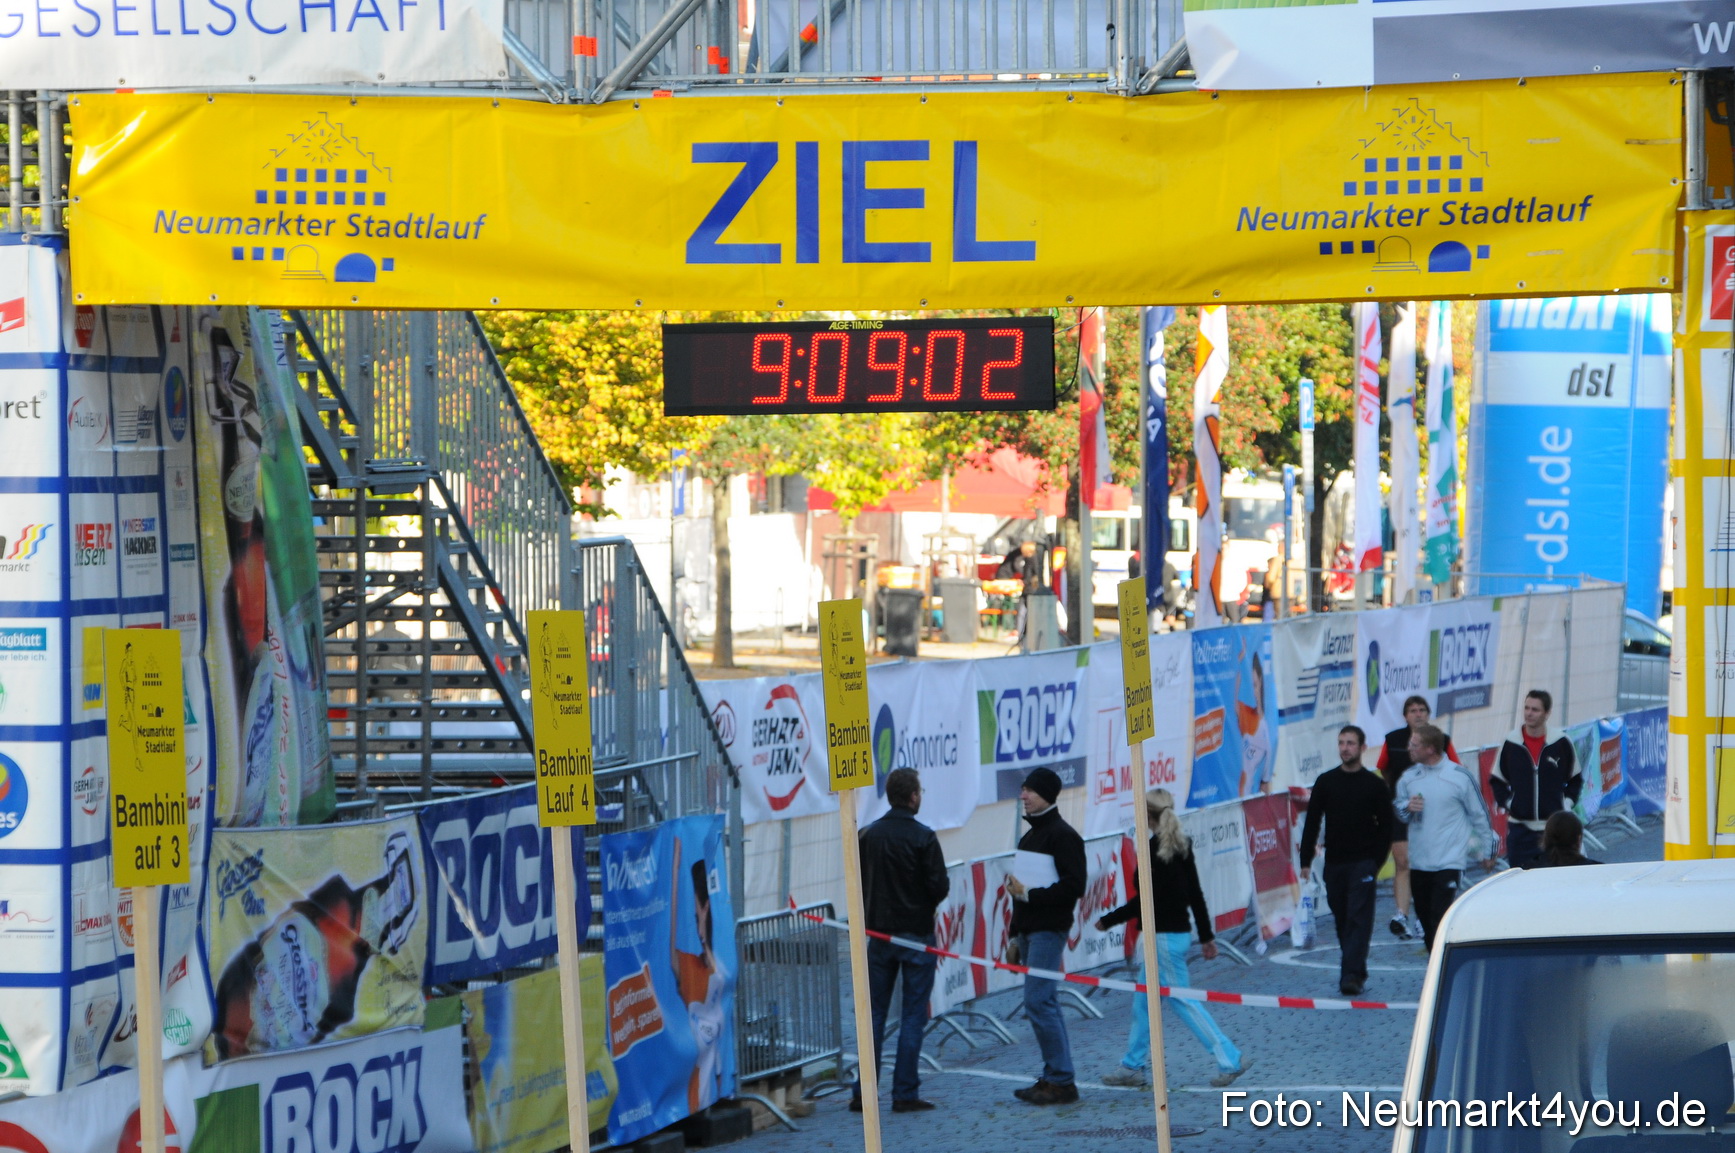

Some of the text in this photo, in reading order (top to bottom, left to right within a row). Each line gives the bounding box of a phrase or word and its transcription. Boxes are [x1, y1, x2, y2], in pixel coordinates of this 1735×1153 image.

[685, 140, 1037, 264] ZIEL
[1237, 195, 1594, 232] Neumarkter Stadtlauf
[154, 209, 488, 240] Neumarkter Stadtlauf
[828, 320, 884, 330] ALGE-TIMING
[1567, 362, 1616, 398] dsl
[840, 671, 862, 680] Neumarkter
[845, 682, 863, 691] Stadtlauf
[553, 691, 583, 702] Neumarkter
[1126, 680, 1152, 708] Bambini
[560, 704, 583, 715] Stadtlauf
[996, 682, 1076, 763] BOCK
[1130, 708, 1152, 735] Lauf 6
[137, 725, 175, 738] Neumarkter
[829, 719, 870, 748] Bambini
[145, 740, 176, 753] Stadtlauf
[539, 747, 592, 777] Bambini
[835, 751, 869, 779] Lauf 5
[1149, 751, 1177, 785] BÖGL
[115, 792, 186, 828] Bambini
[546, 783, 589, 813] Lauf 4
[134, 835, 181, 871] auf 3
[264, 1046, 427, 1153] BOCK
